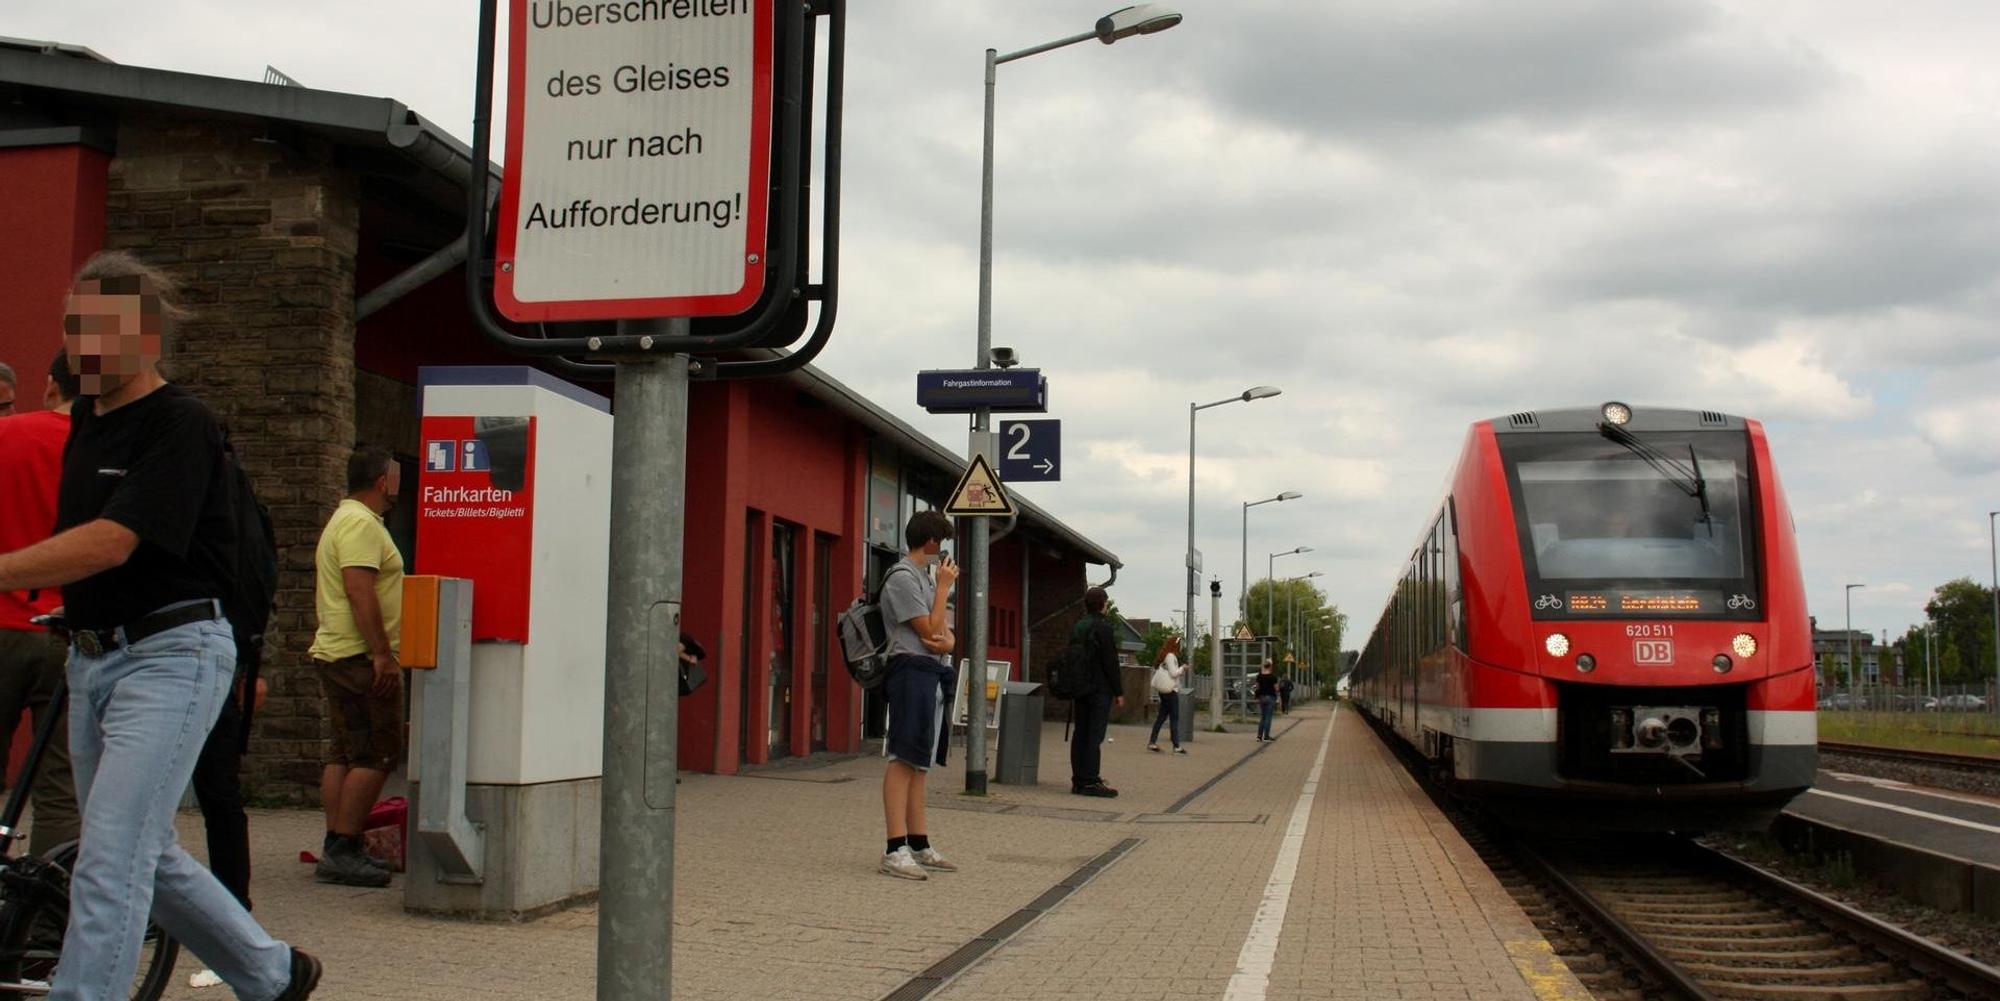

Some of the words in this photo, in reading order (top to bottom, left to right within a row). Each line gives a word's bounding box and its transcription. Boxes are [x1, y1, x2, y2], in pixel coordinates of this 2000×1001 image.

[547, 70, 602, 97] des
[613, 63, 730, 93] Gleises
[567, 138, 617, 161] nur
[628, 128, 702, 158] nach
[525, 193, 741, 230] Aufforderung!
[943, 379, 1012, 388] Fahrgastinformation
[1007, 423, 1031, 460] 2
[424, 486, 512, 503] Fahrkarten
[424, 507, 525, 519] Tickets/Billets/Biglietti
[1626, 624, 1650, 637] 620
[1653, 624, 1673, 637] 511
[1639, 643, 1670, 661] DB
